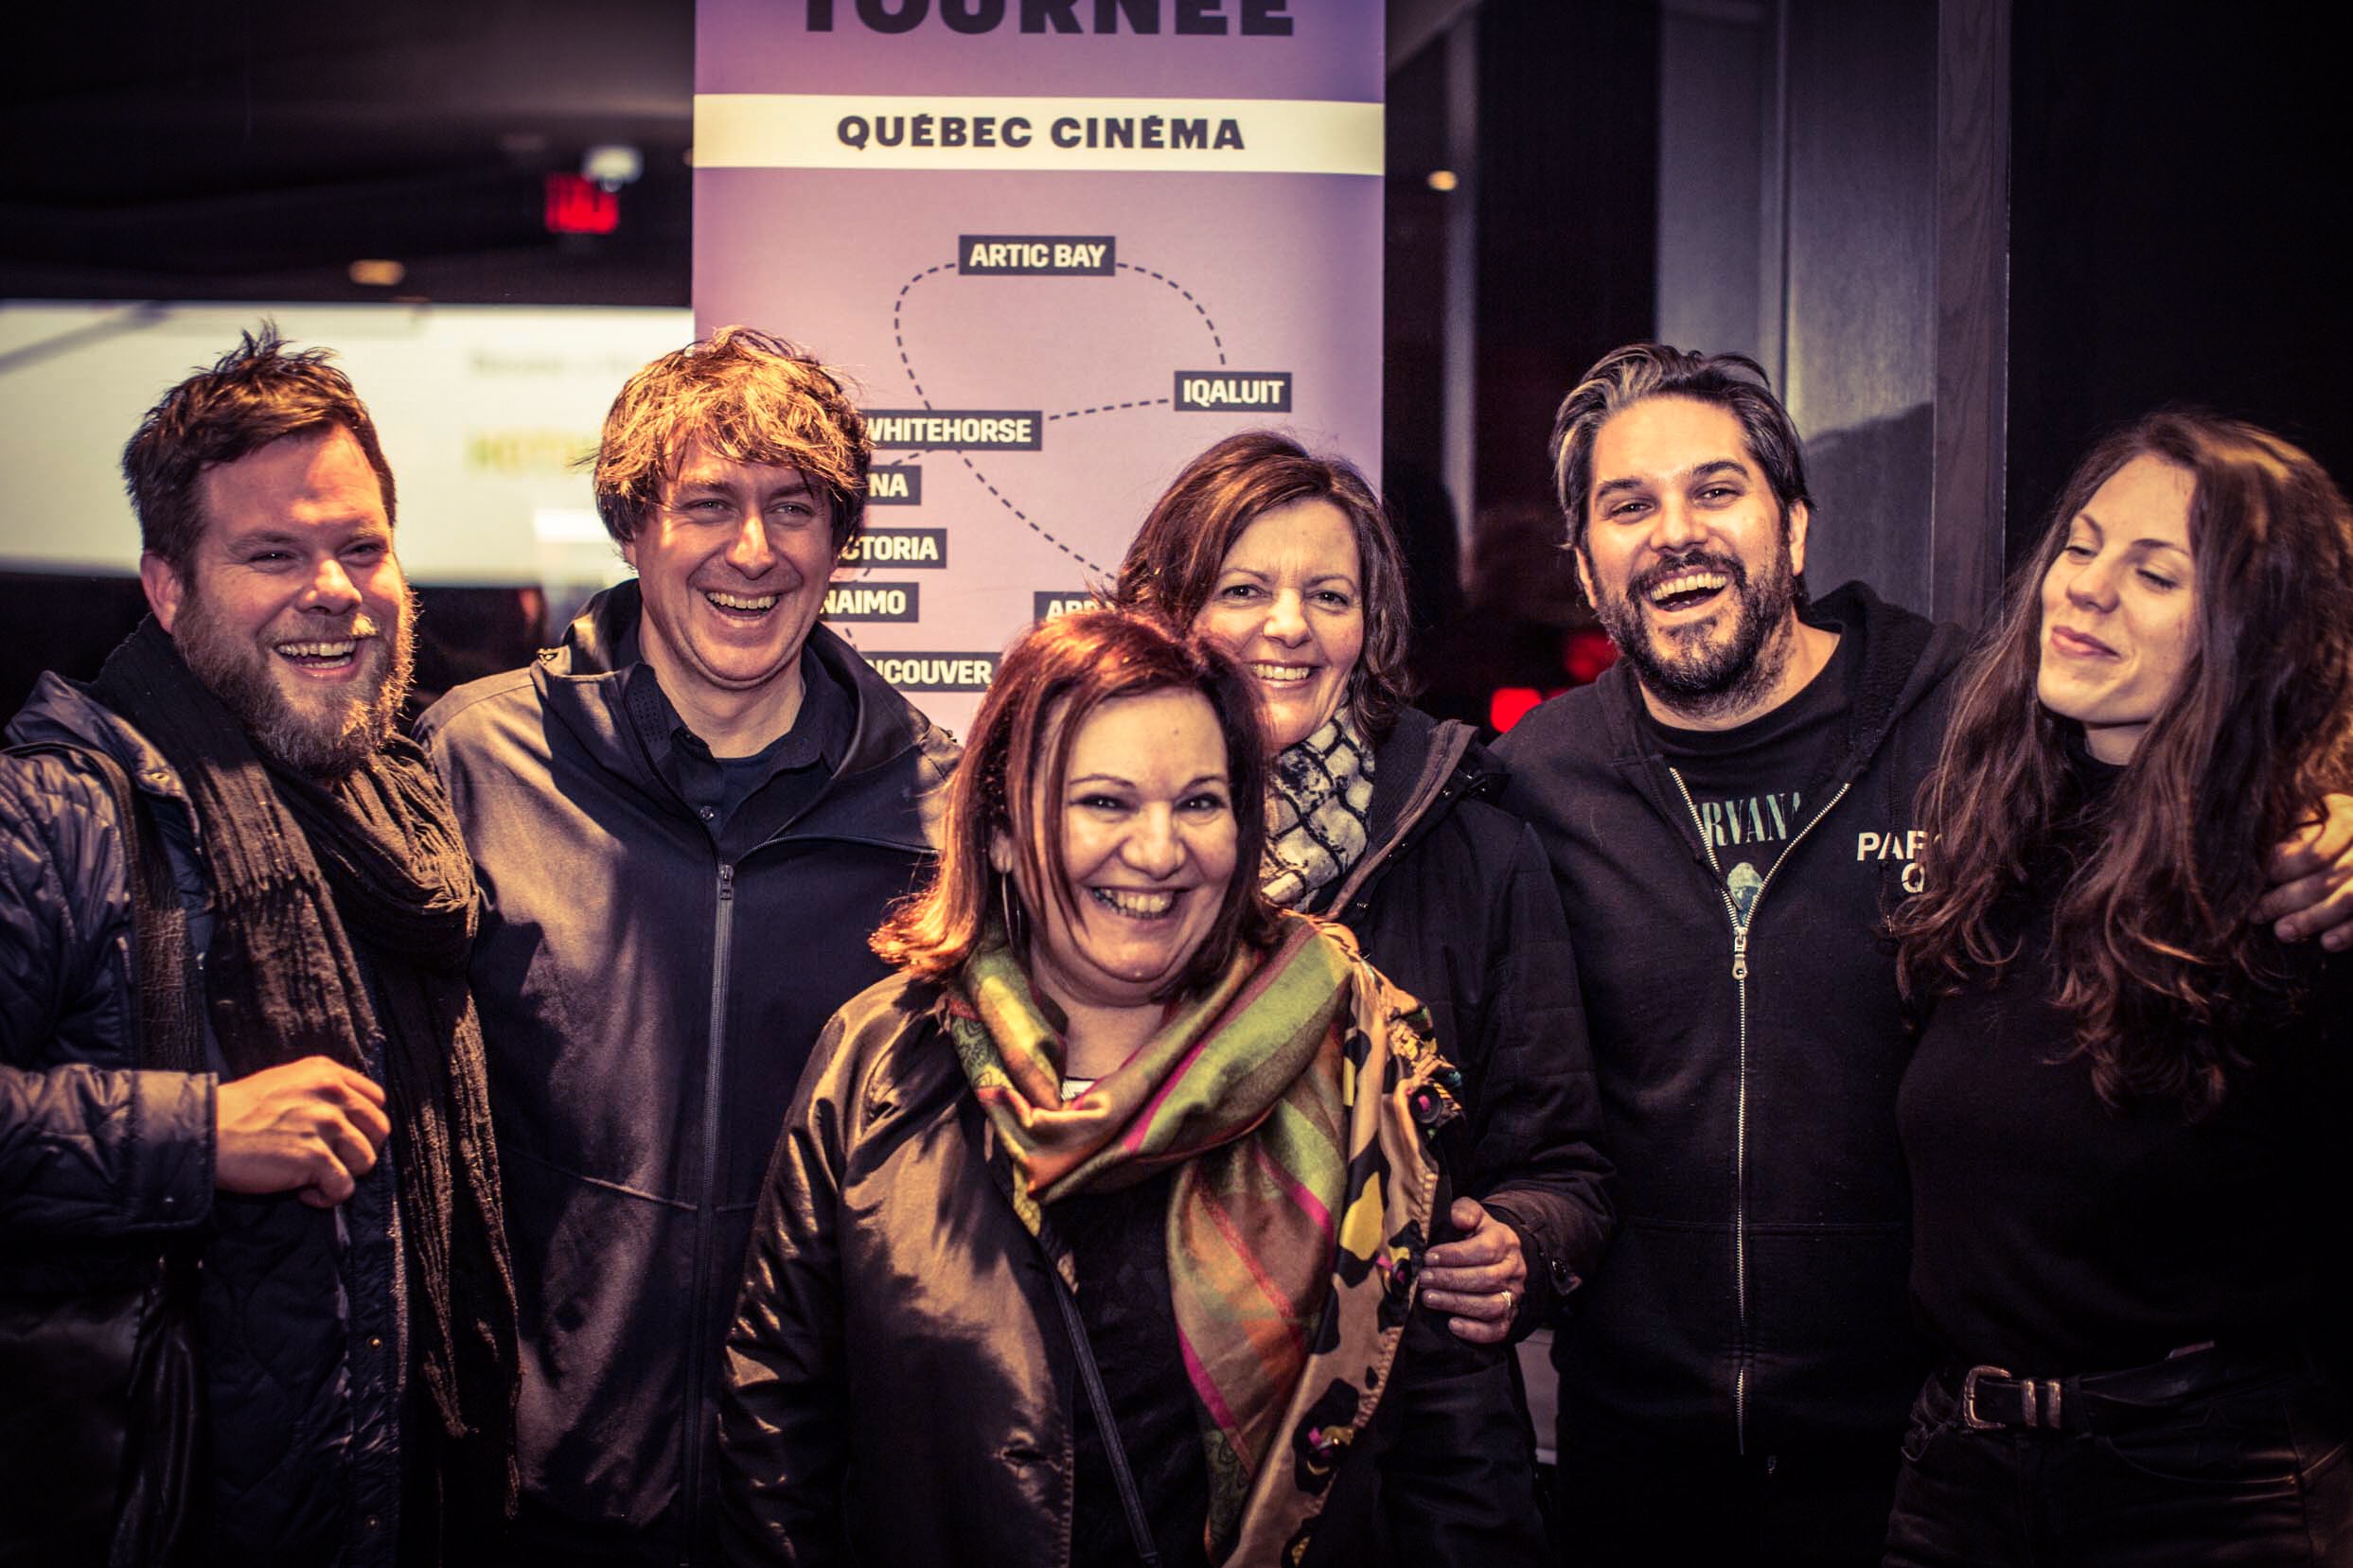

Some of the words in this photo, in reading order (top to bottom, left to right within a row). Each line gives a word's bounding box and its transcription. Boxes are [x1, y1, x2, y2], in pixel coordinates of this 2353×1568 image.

[837, 114, 1033, 150] QUÉBEC
[1050, 115, 1246, 150] CINÉMA
[969, 243, 1050, 268] ARTIC
[1053, 244, 1106, 268] BAY
[1183, 379, 1285, 408] IQALUIT
[865, 417, 1032, 443] WHITEHORSE
[867, 472, 910, 498] NA
[838, 536, 939, 560] CTORIA
[819, 590, 907, 614] NAIMO
[1693, 792, 1800, 847] RVAN
